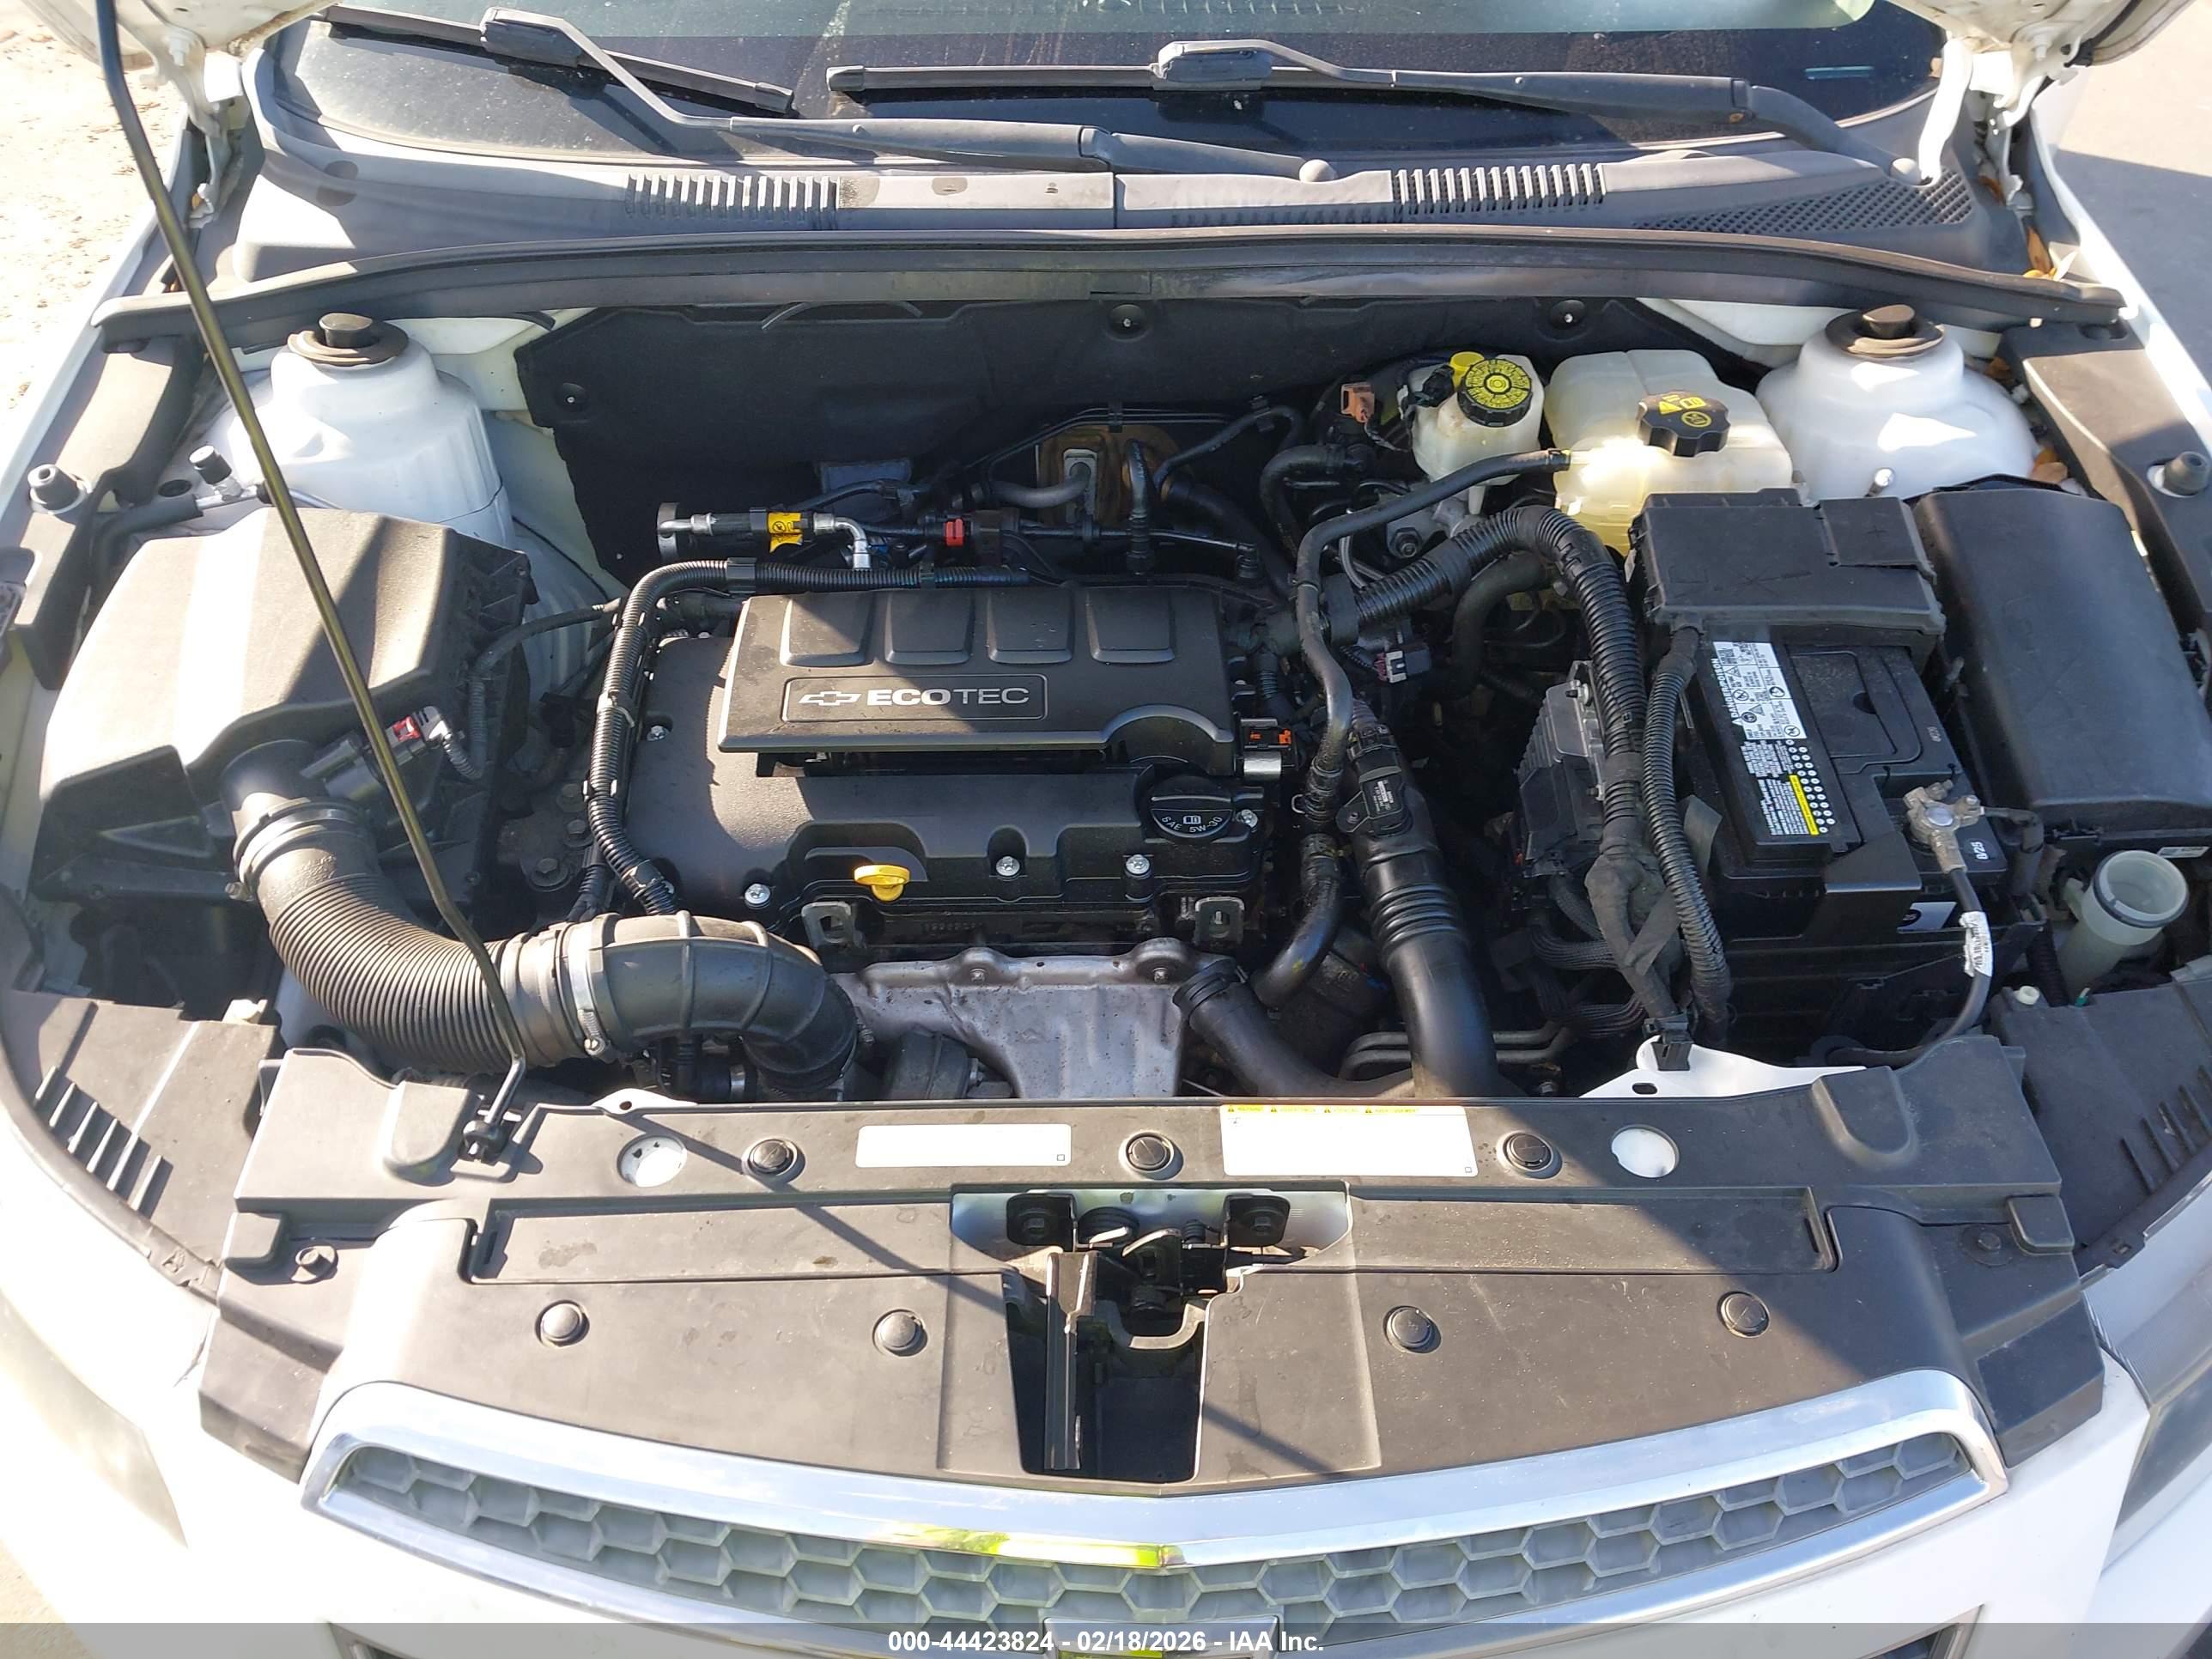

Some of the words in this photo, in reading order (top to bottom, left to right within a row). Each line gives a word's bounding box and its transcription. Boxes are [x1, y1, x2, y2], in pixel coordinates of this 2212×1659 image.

[866, 687, 1030, 706] ECOTEC
[1161, 816, 1182, 830] SAE
[1189, 816, 1223, 833] 5W-30
